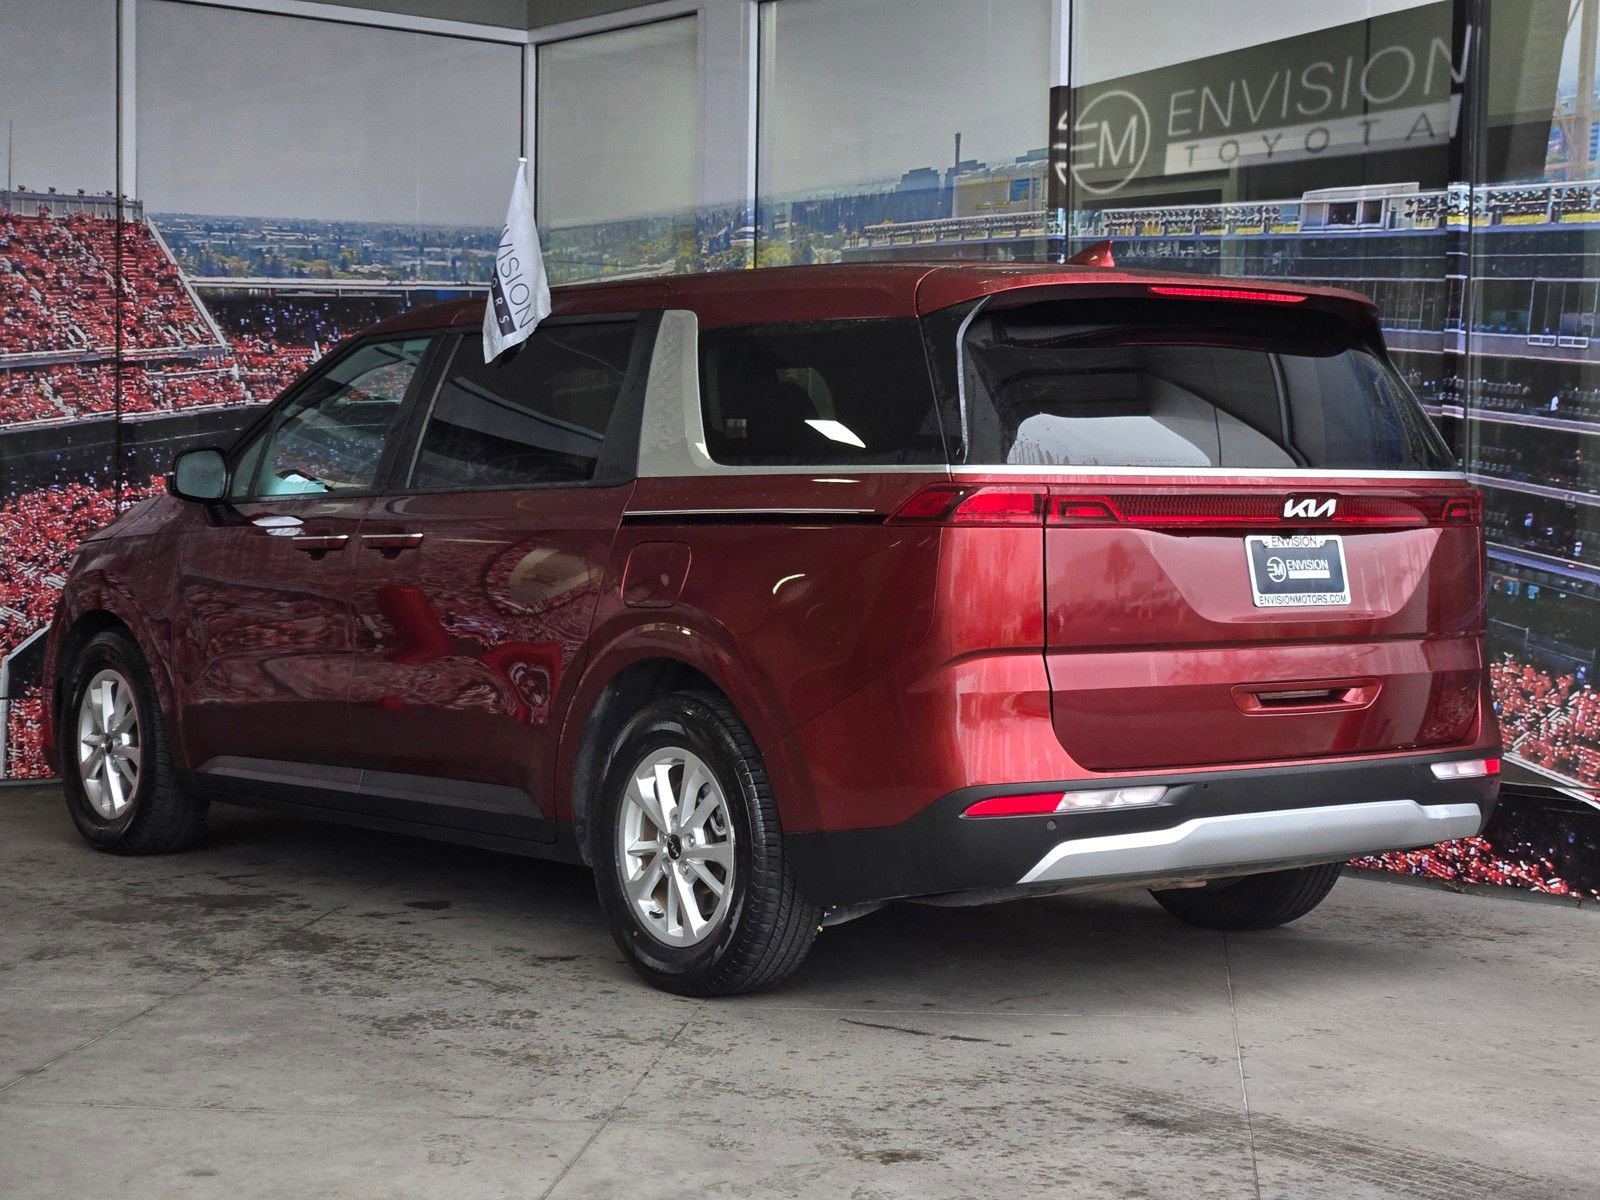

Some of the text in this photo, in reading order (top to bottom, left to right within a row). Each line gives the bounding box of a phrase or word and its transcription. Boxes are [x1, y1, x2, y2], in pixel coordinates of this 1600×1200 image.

[1168, 25, 1471, 137] ENVISION
[1184, 111, 1436, 165] TOYOTA
[1271, 537, 1317, 547] ENVISION
[1286, 560, 1329, 570] ENVISION
[1260, 595, 1346, 605] ENVISIONMOTORS.COM
